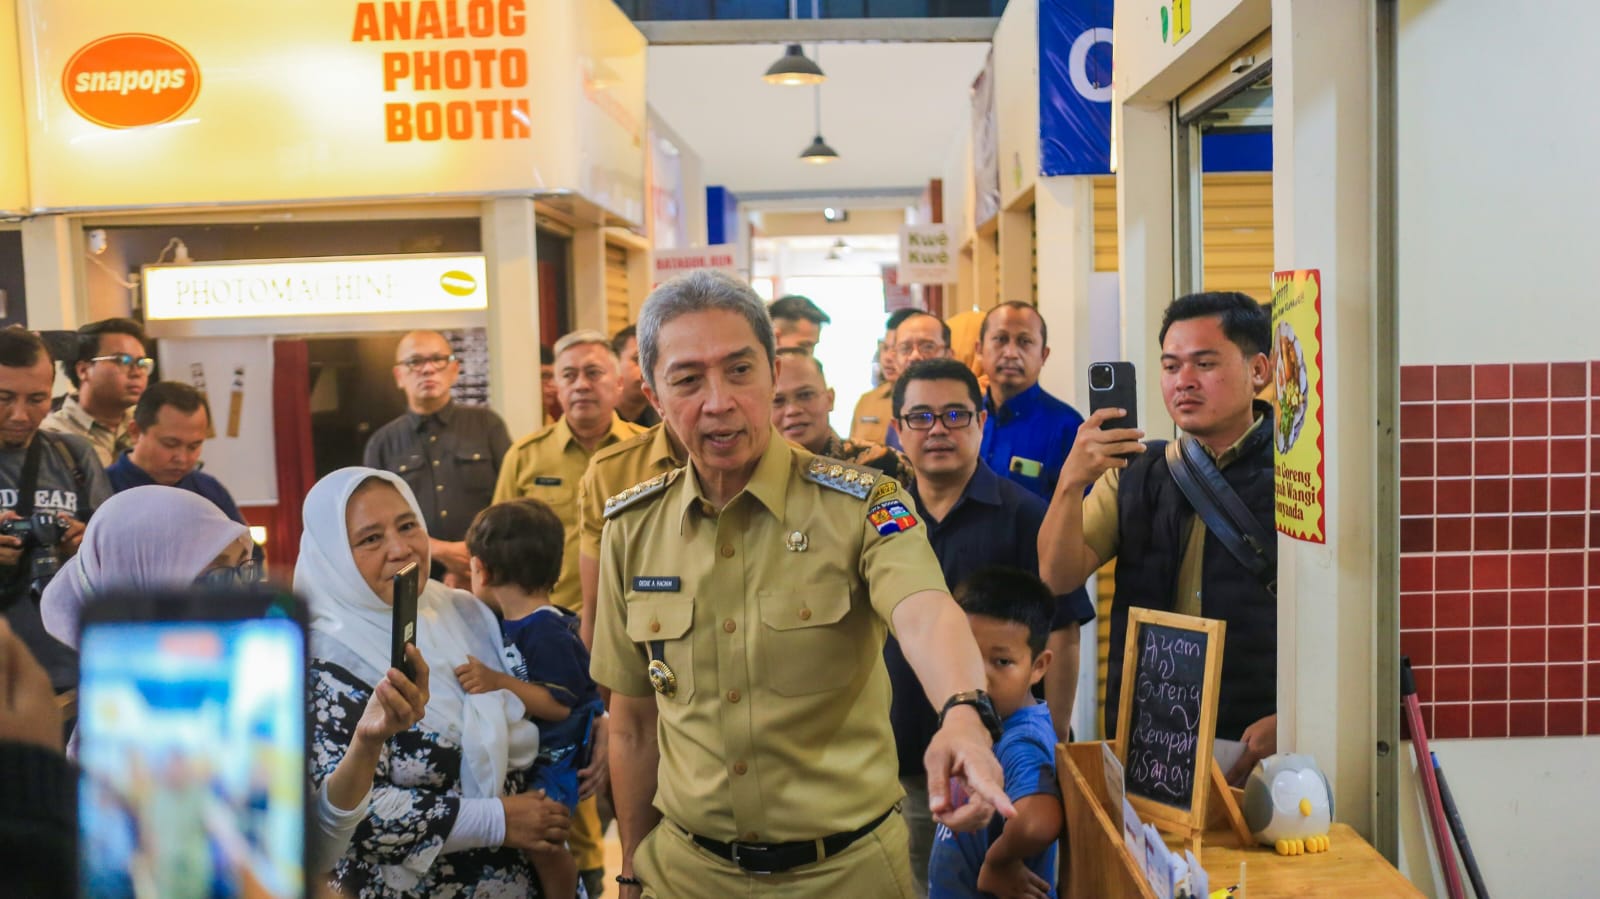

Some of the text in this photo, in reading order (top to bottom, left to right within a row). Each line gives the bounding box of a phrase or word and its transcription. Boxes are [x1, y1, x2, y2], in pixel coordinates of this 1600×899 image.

[352, 0, 526, 42] ANALOG
[75, 67, 187, 96] snapops
[383, 48, 528, 92] PHOTO
[384, 99, 531, 143] BOOTH
[1281, 462, 1311, 488] Goreng
[1287, 481, 1315, 507] Wangi
[1141, 630, 1201, 680] Ayam
